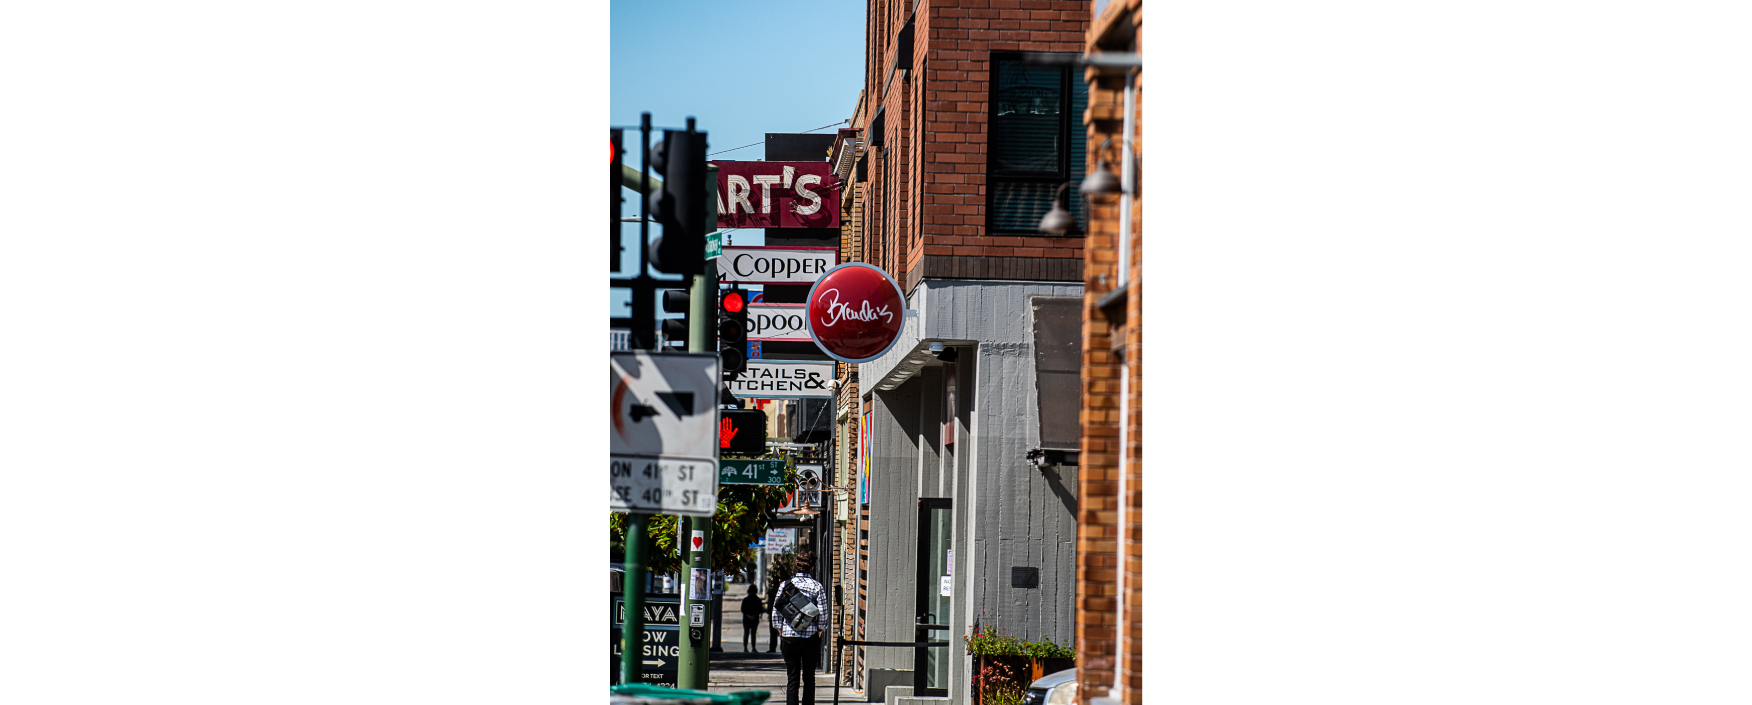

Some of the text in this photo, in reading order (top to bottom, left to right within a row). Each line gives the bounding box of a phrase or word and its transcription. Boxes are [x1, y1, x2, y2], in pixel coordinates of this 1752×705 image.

[818, 288, 893, 327] Brenda's
[677, 464, 696, 482] ST
[767, 476, 781, 484] 300
[681, 489, 699, 506] ST
[620, 605, 677, 622] AYA
[614, 644, 680, 657] LSING
